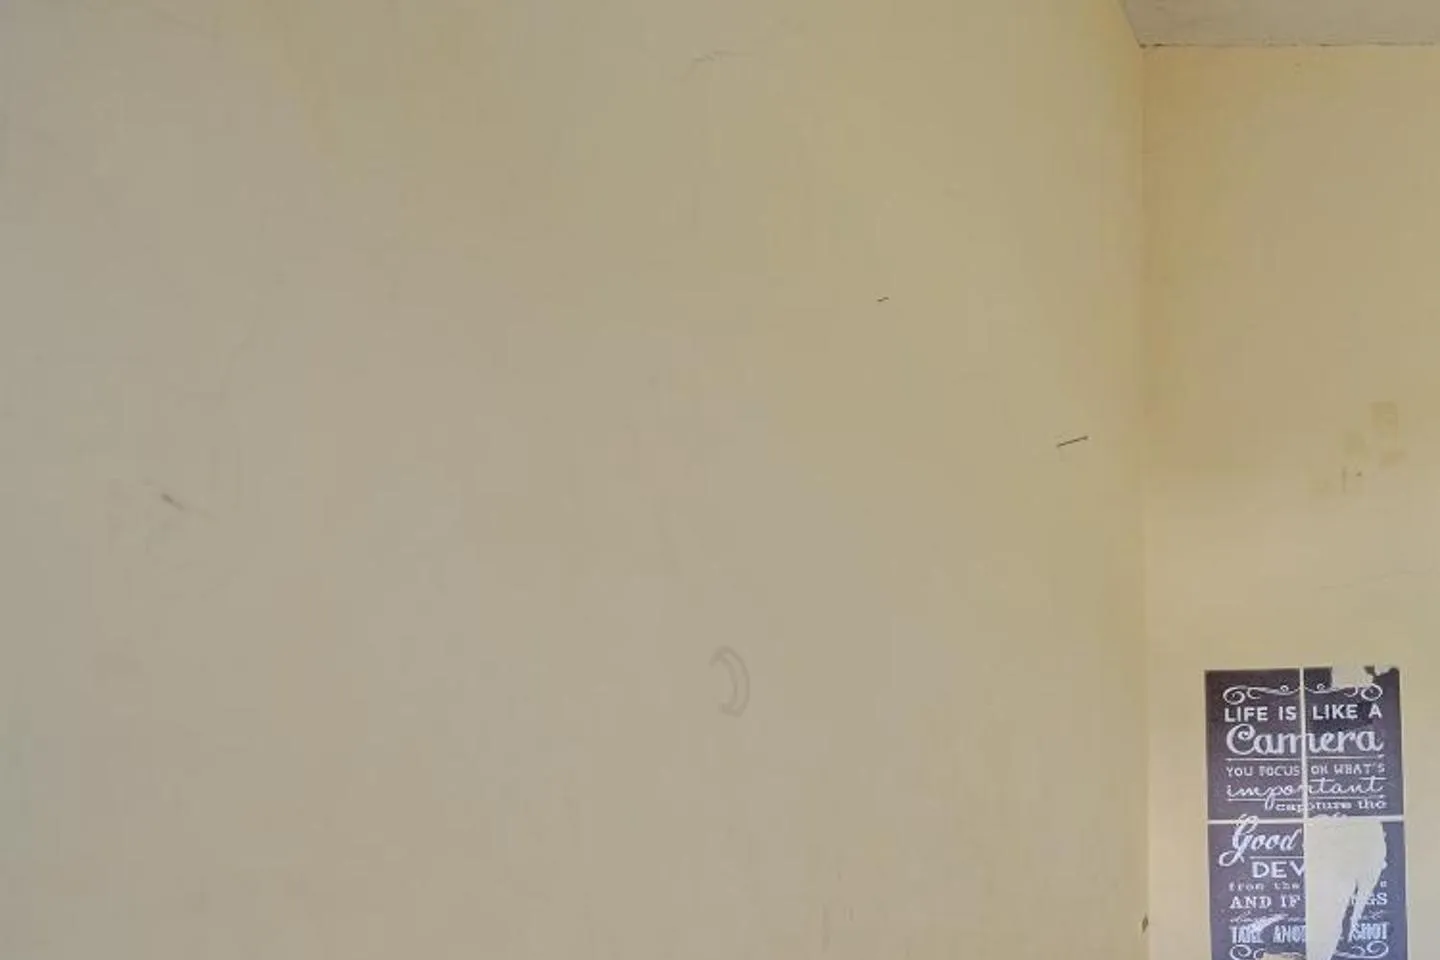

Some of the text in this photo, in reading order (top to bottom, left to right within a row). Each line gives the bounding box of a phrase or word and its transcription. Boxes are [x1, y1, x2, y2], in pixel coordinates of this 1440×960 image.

[1224, 703, 1383, 723] LIFE IS LIKE A
[1226, 723, 1384, 755] Camera
[1226, 763, 1386, 777] YOU FOCUS ON WHAT'S
[1226, 776, 1387, 811] important
[1358, 798, 1388, 810] the
[1218, 813, 1302, 867] Good
[1274, 881, 1300, 891] the
[1228, 894, 1300, 909] AND IF
